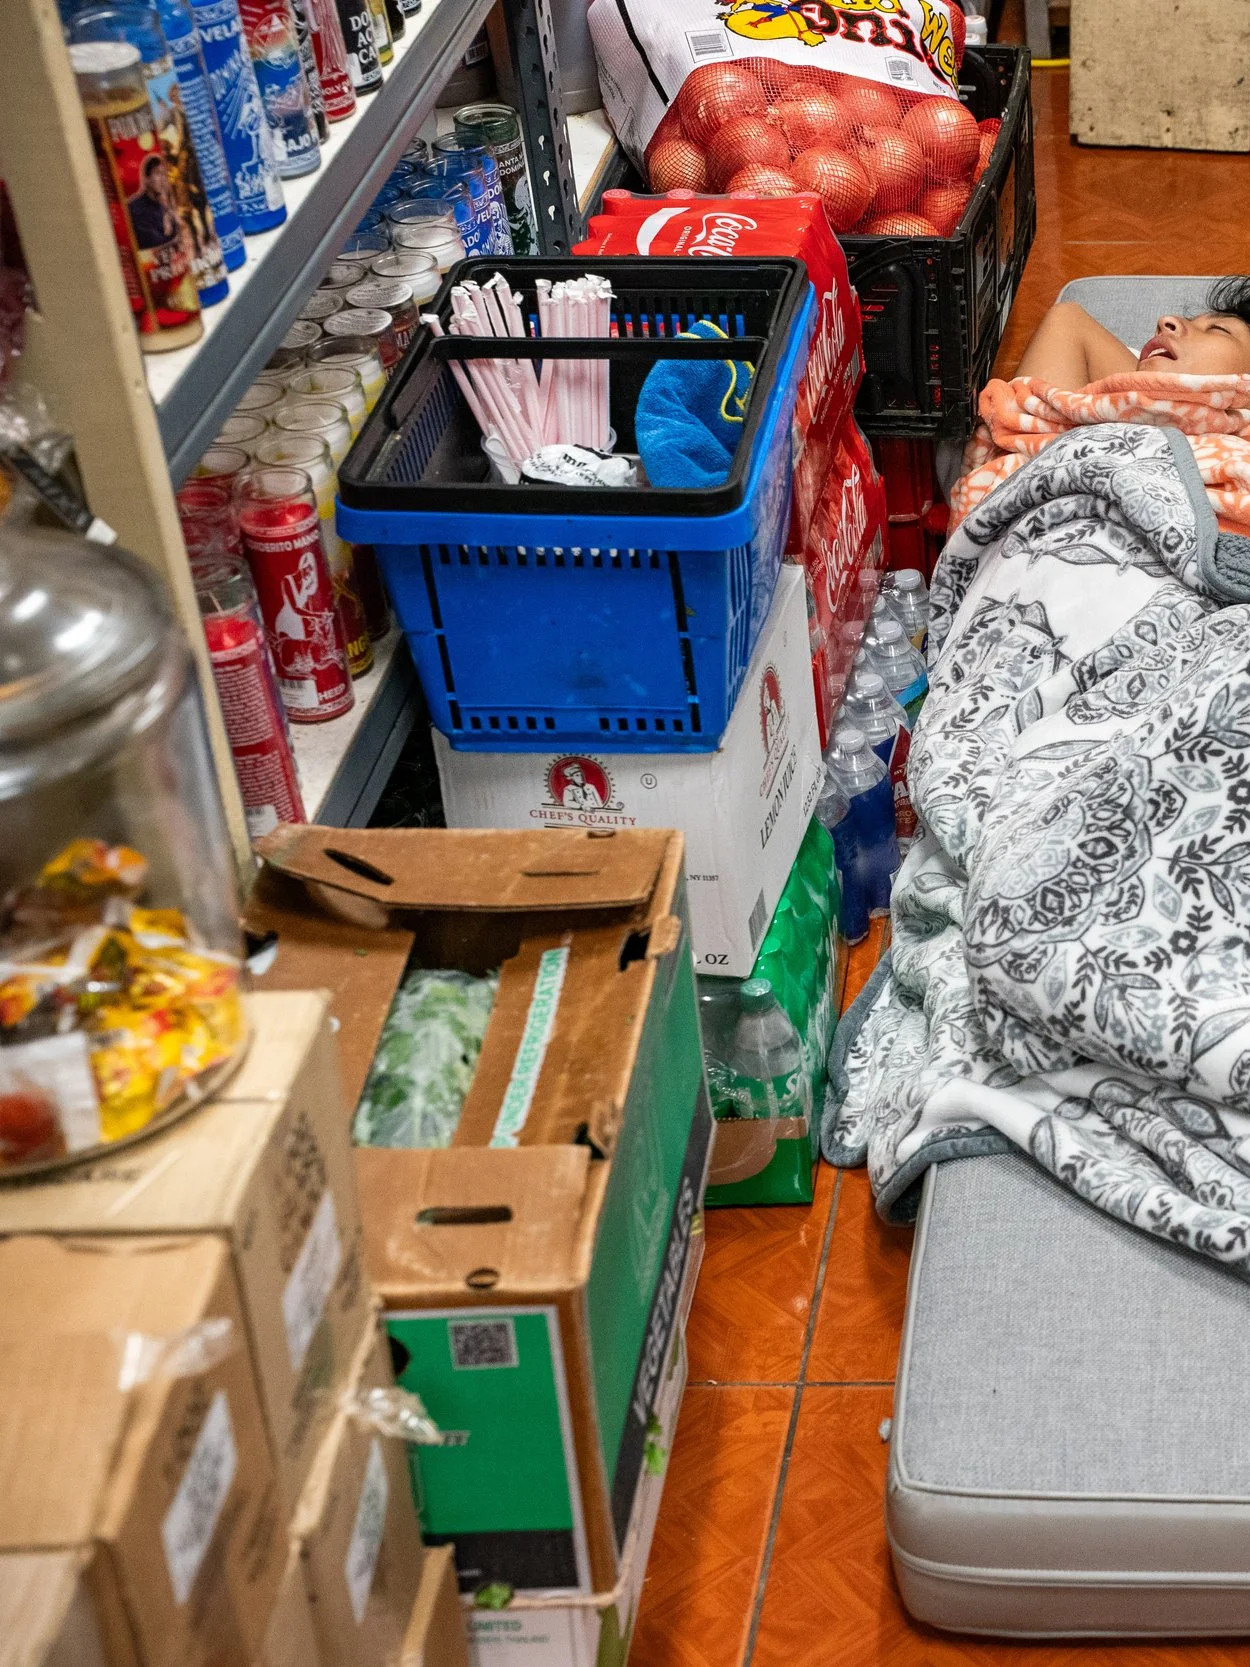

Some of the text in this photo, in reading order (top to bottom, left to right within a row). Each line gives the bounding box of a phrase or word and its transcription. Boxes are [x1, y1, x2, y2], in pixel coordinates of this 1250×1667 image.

[499, 156, 519, 168] ANTA
[529, 808, 637, 826] CHEF'S QUALITY
[704, 953, 729, 966] OZ
